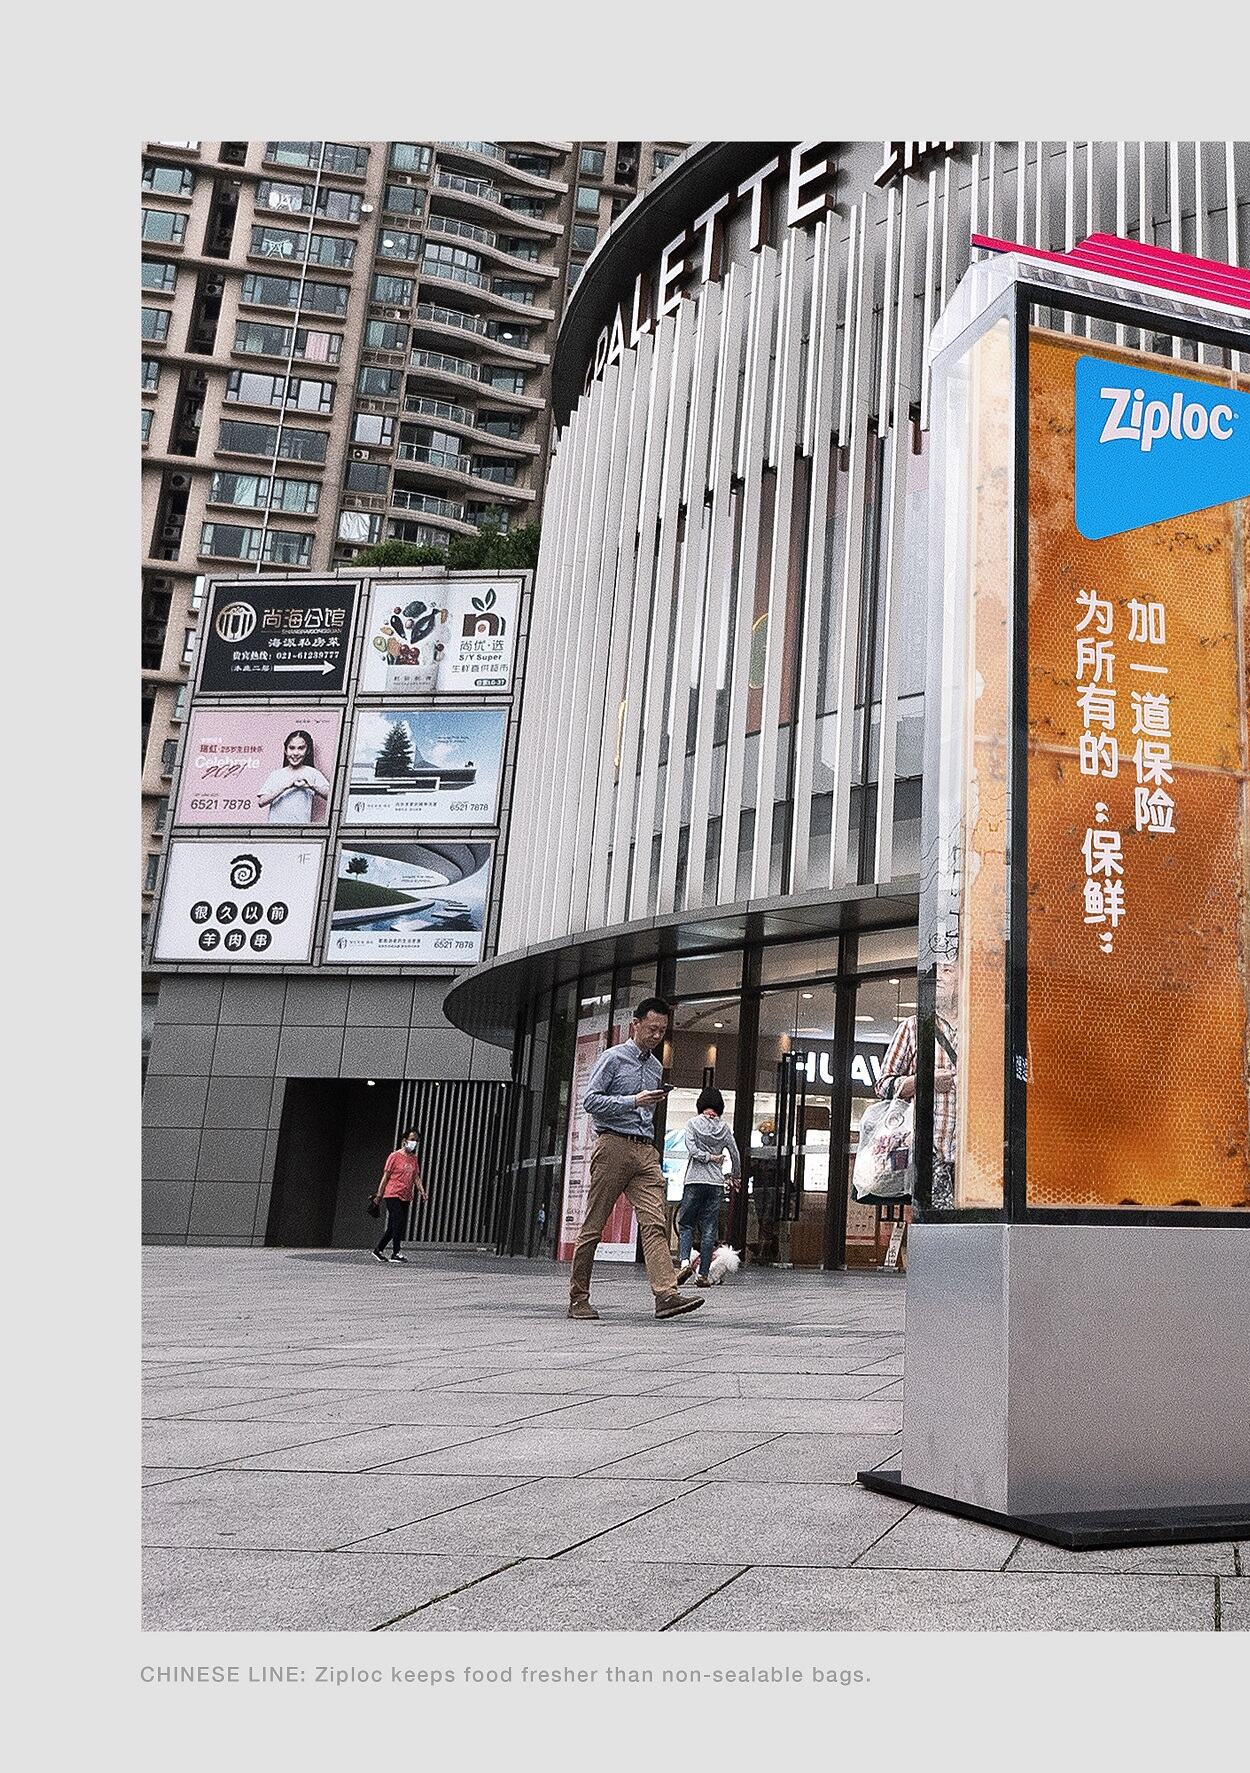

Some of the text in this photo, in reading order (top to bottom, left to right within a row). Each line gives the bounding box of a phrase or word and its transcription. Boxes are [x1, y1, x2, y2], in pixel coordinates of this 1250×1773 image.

[594, 141, 834, 380] PALETTE
[1099, 387, 1233, 451] Ziploc
[262, 608, 346, 628] 尚海公馆
[476, 654, 502, 662] Super
[1127, 598, 1176, 833] 加一道保险
[202, 763, 248, 780] 2021
[191, 799, 251, 810] 6521 7878
[449, 803, 489, 812] 6521 7878
[194, 905, 285, 921] 很久以前
[202, 933, 268, 948] 羊肉串
[433, 940, 474, 949] 6521 7878
[796, 1051, 882, 1087] HUA
